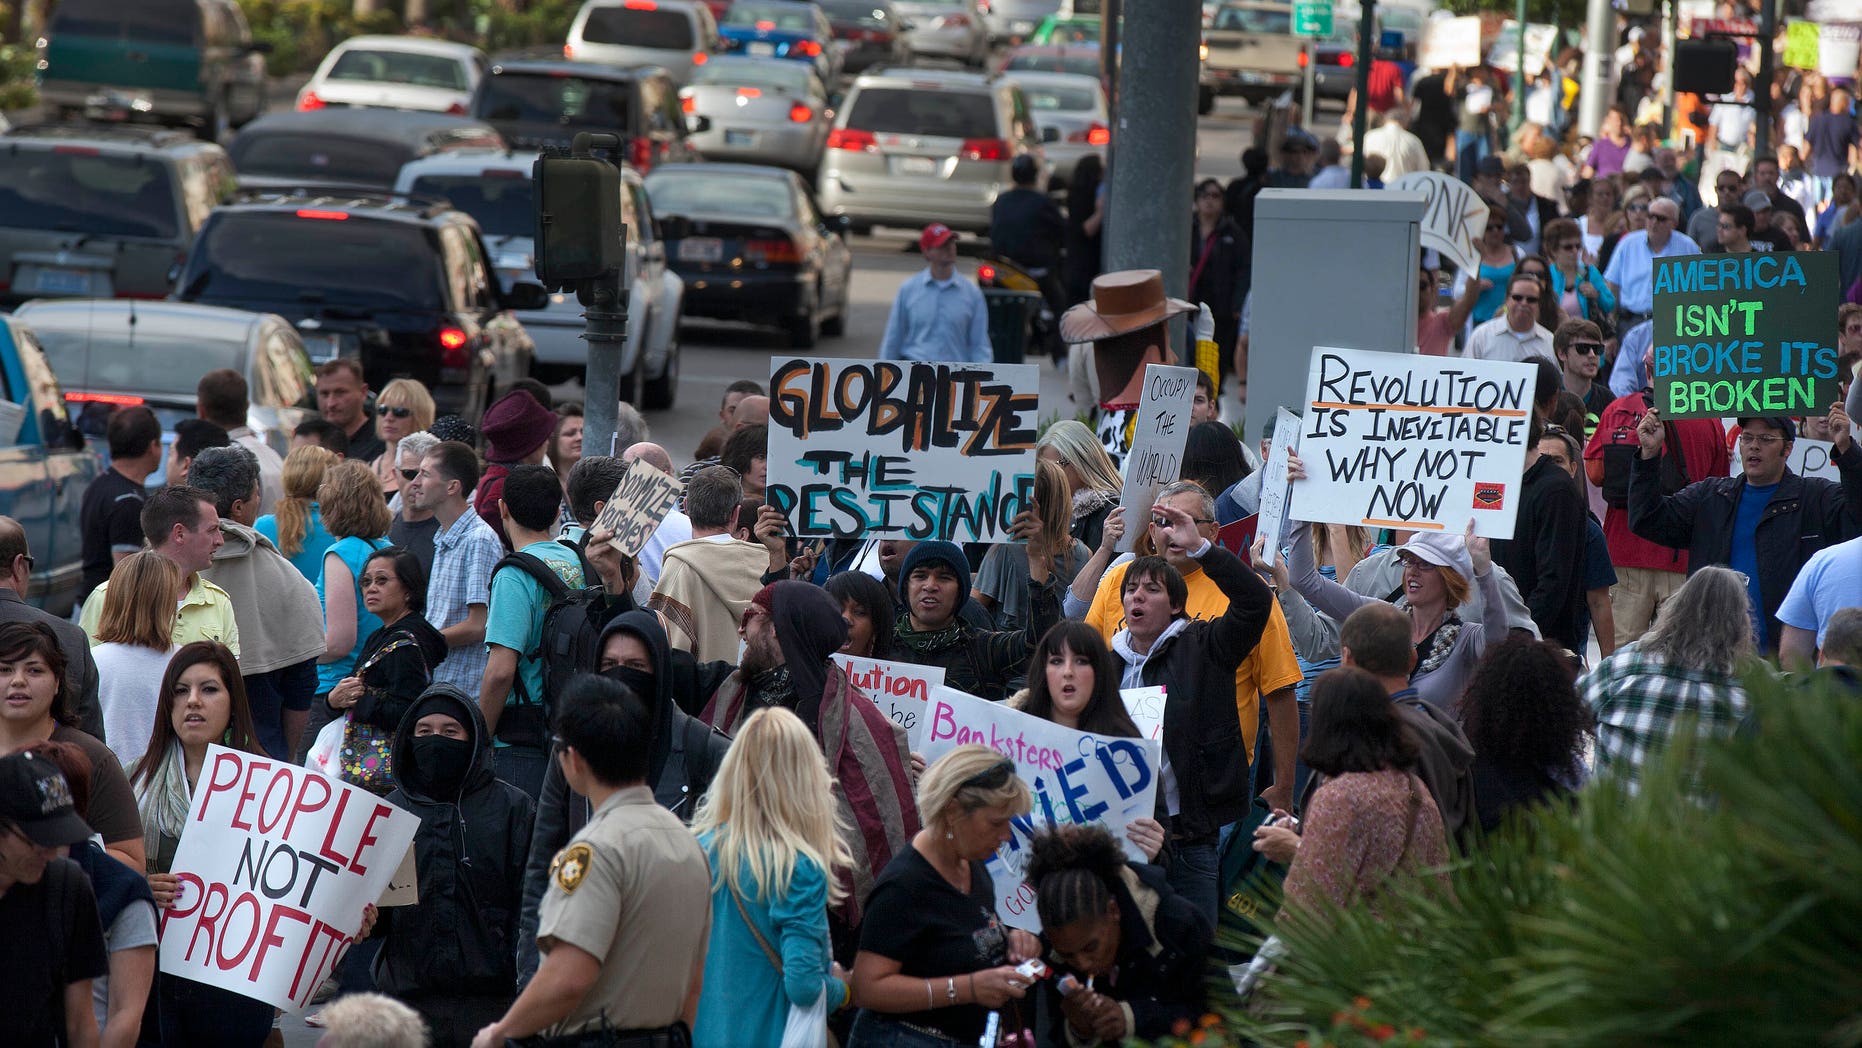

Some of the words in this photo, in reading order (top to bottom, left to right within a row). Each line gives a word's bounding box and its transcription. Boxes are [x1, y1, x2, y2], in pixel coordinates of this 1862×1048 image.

[1402, 175, 1485, 259] ONK
[1675, 298, 1764, 337] ISN'T
[1655, 339, 1765, 377] BROKE
[1780, 341, 1839, 379] ITS
[769, 358, 1039, 456] GLOBALIZE
[1150, 375, 1190, 402] OCCUPY
[1669, 376, 1816, 414] BROKEN
[1155, 410, 1177, 437] THE
[1306, 407, 1350, 438] IS
[795, 448, 918, 492] THE
[1136, 445, 1177, 487] WORLD
[1325, 446, 1408, 484] WHY
[1413, 447, 1487, 482] NOT
[766, 468, 1035, 542] RESISTANCE
[1365, 479, 1449, 522] NOW
[844, 660, 928, 702] lution
[890, 702, 916, 730] be
[196, 752, 393, 877] PEOPLE
[232, 837, 341, 909] NOT
